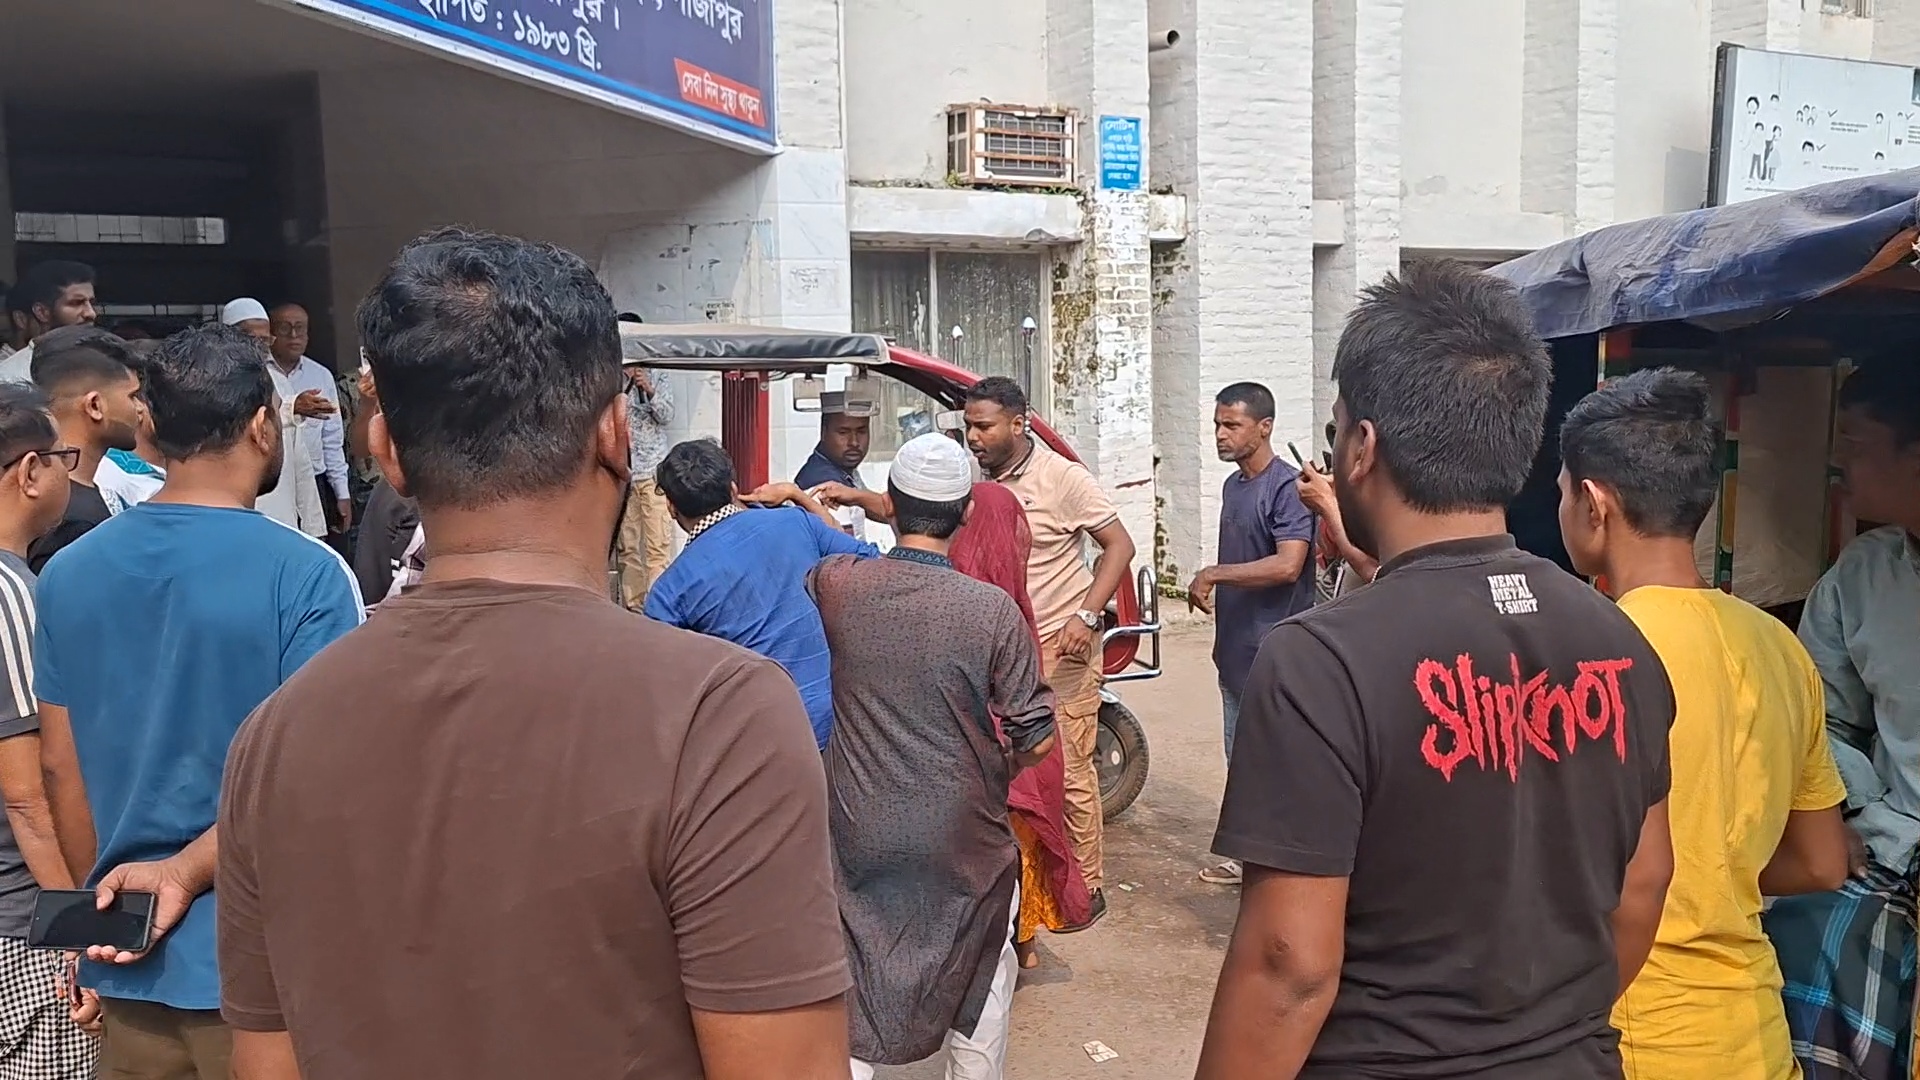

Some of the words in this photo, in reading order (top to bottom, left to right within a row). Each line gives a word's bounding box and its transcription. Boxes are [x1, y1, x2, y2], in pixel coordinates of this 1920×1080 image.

[513, 9, 571, 56] ১৯৮৩
[682, 71, 702, 99] সেবা
[703, 71, 720, 105] নিন
[738, 92, 760, 123] থাকুন
[1487, 573, 1527, 589] HEAVY
[1490, 586, 1533, 601] METAL
